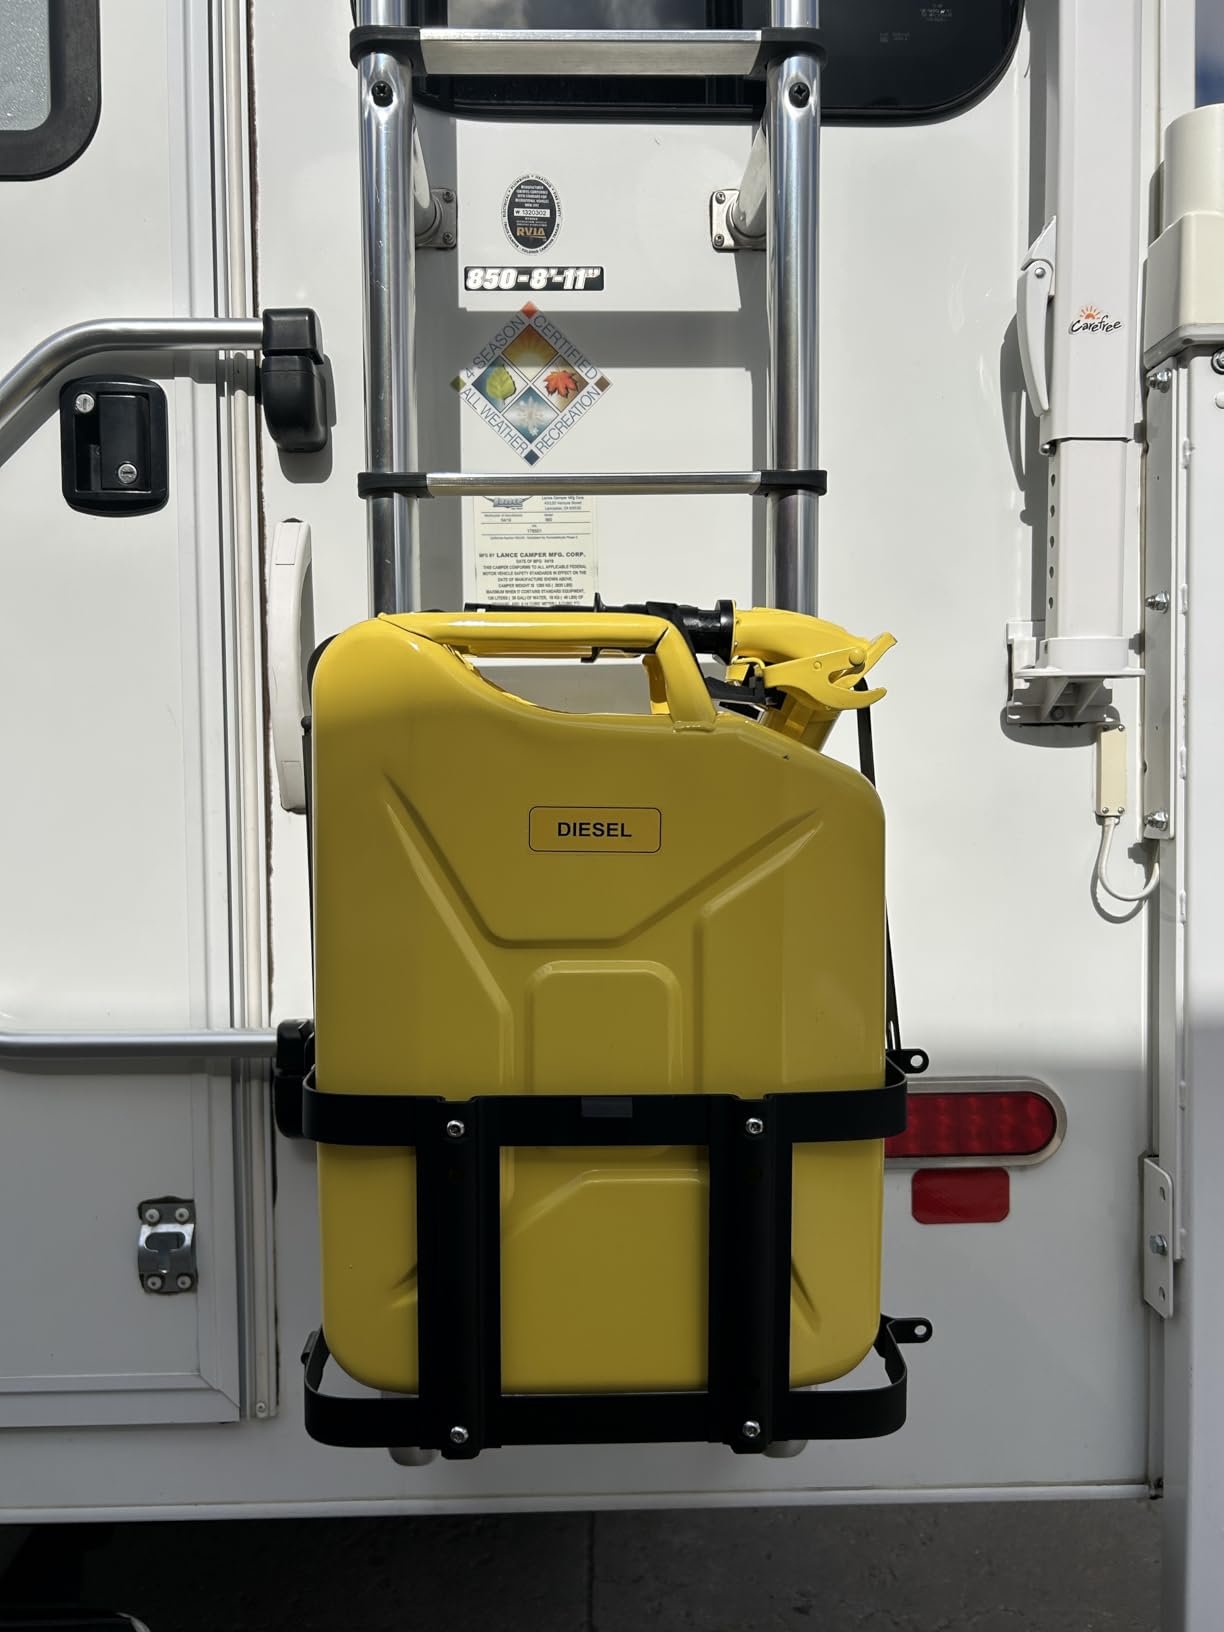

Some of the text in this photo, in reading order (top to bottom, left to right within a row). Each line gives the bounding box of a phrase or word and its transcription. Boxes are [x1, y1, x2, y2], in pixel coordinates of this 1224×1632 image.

[517, 227, 545, 236] RVIA
[465, 314, 525, 379] 4 SEASON
[533, 314, 598, 380] CERTIFIED
[1071, 315, 1122, 332] Carefree
[461, 387, 529, 455] ALL WEATHER
[535, 386, 601, 454] RECREATION
[558, 822, 632, 837] DIESEL
